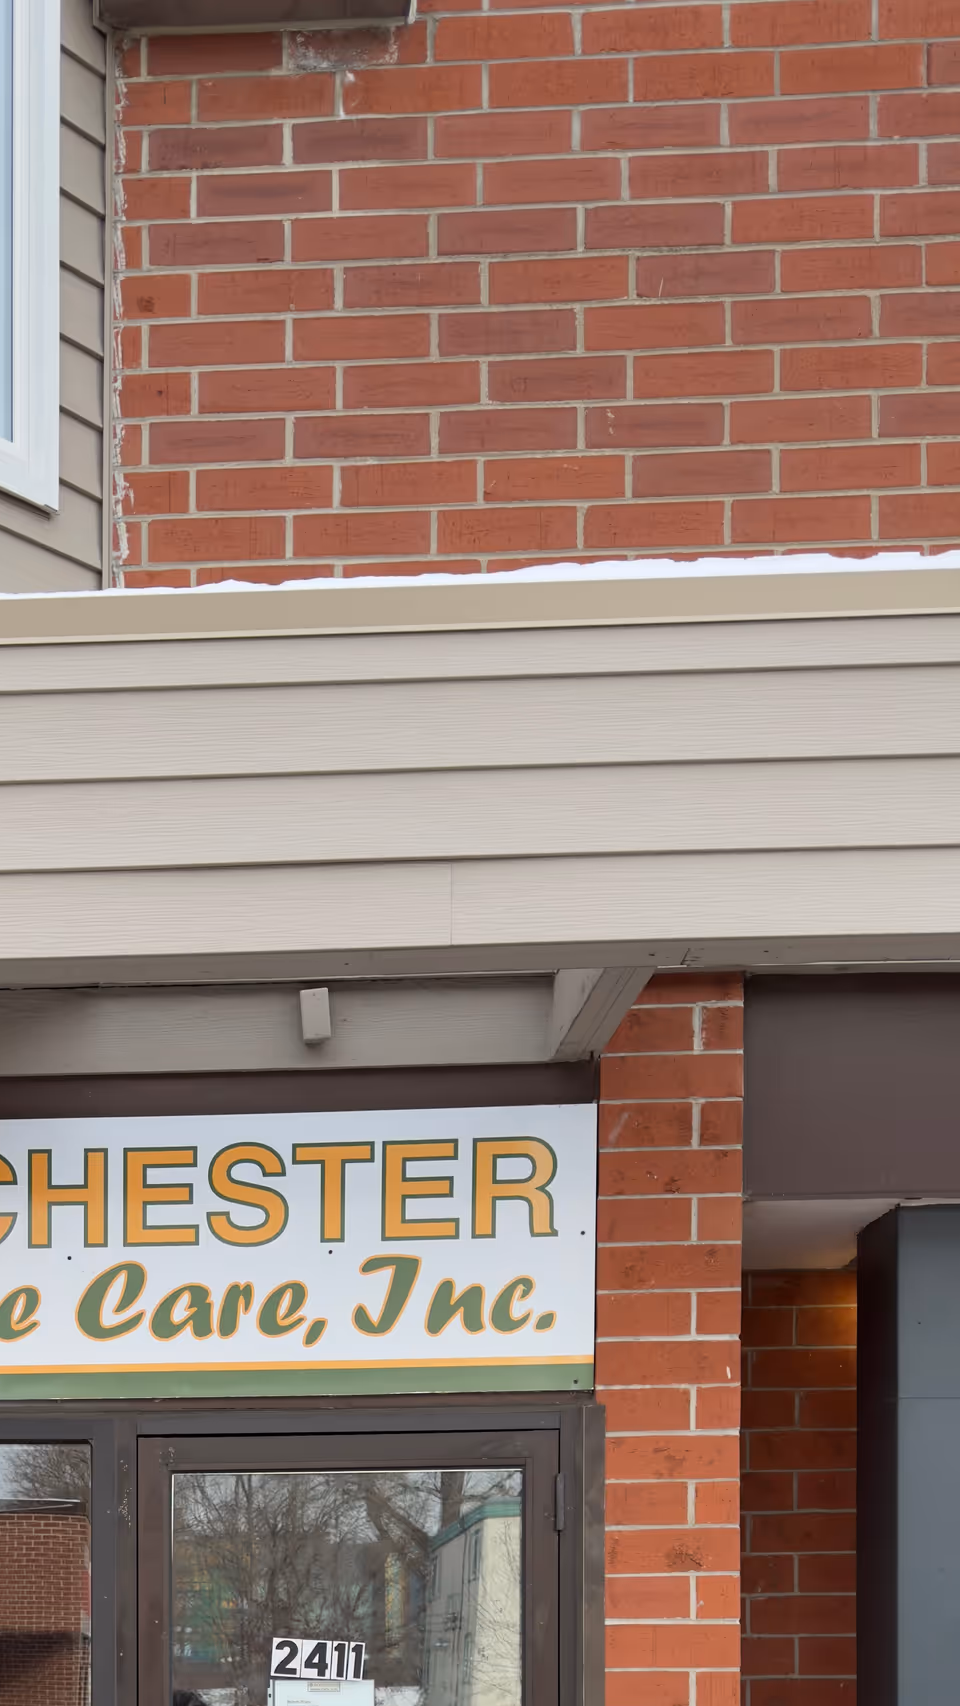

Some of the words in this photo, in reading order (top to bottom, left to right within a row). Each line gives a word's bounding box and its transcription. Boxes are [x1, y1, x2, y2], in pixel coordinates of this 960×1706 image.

[75, 1260, 328, 1348] Care,
[352, 1253, 557, 1337] Inc.
[273, 1640, 364, 1680] 2411
